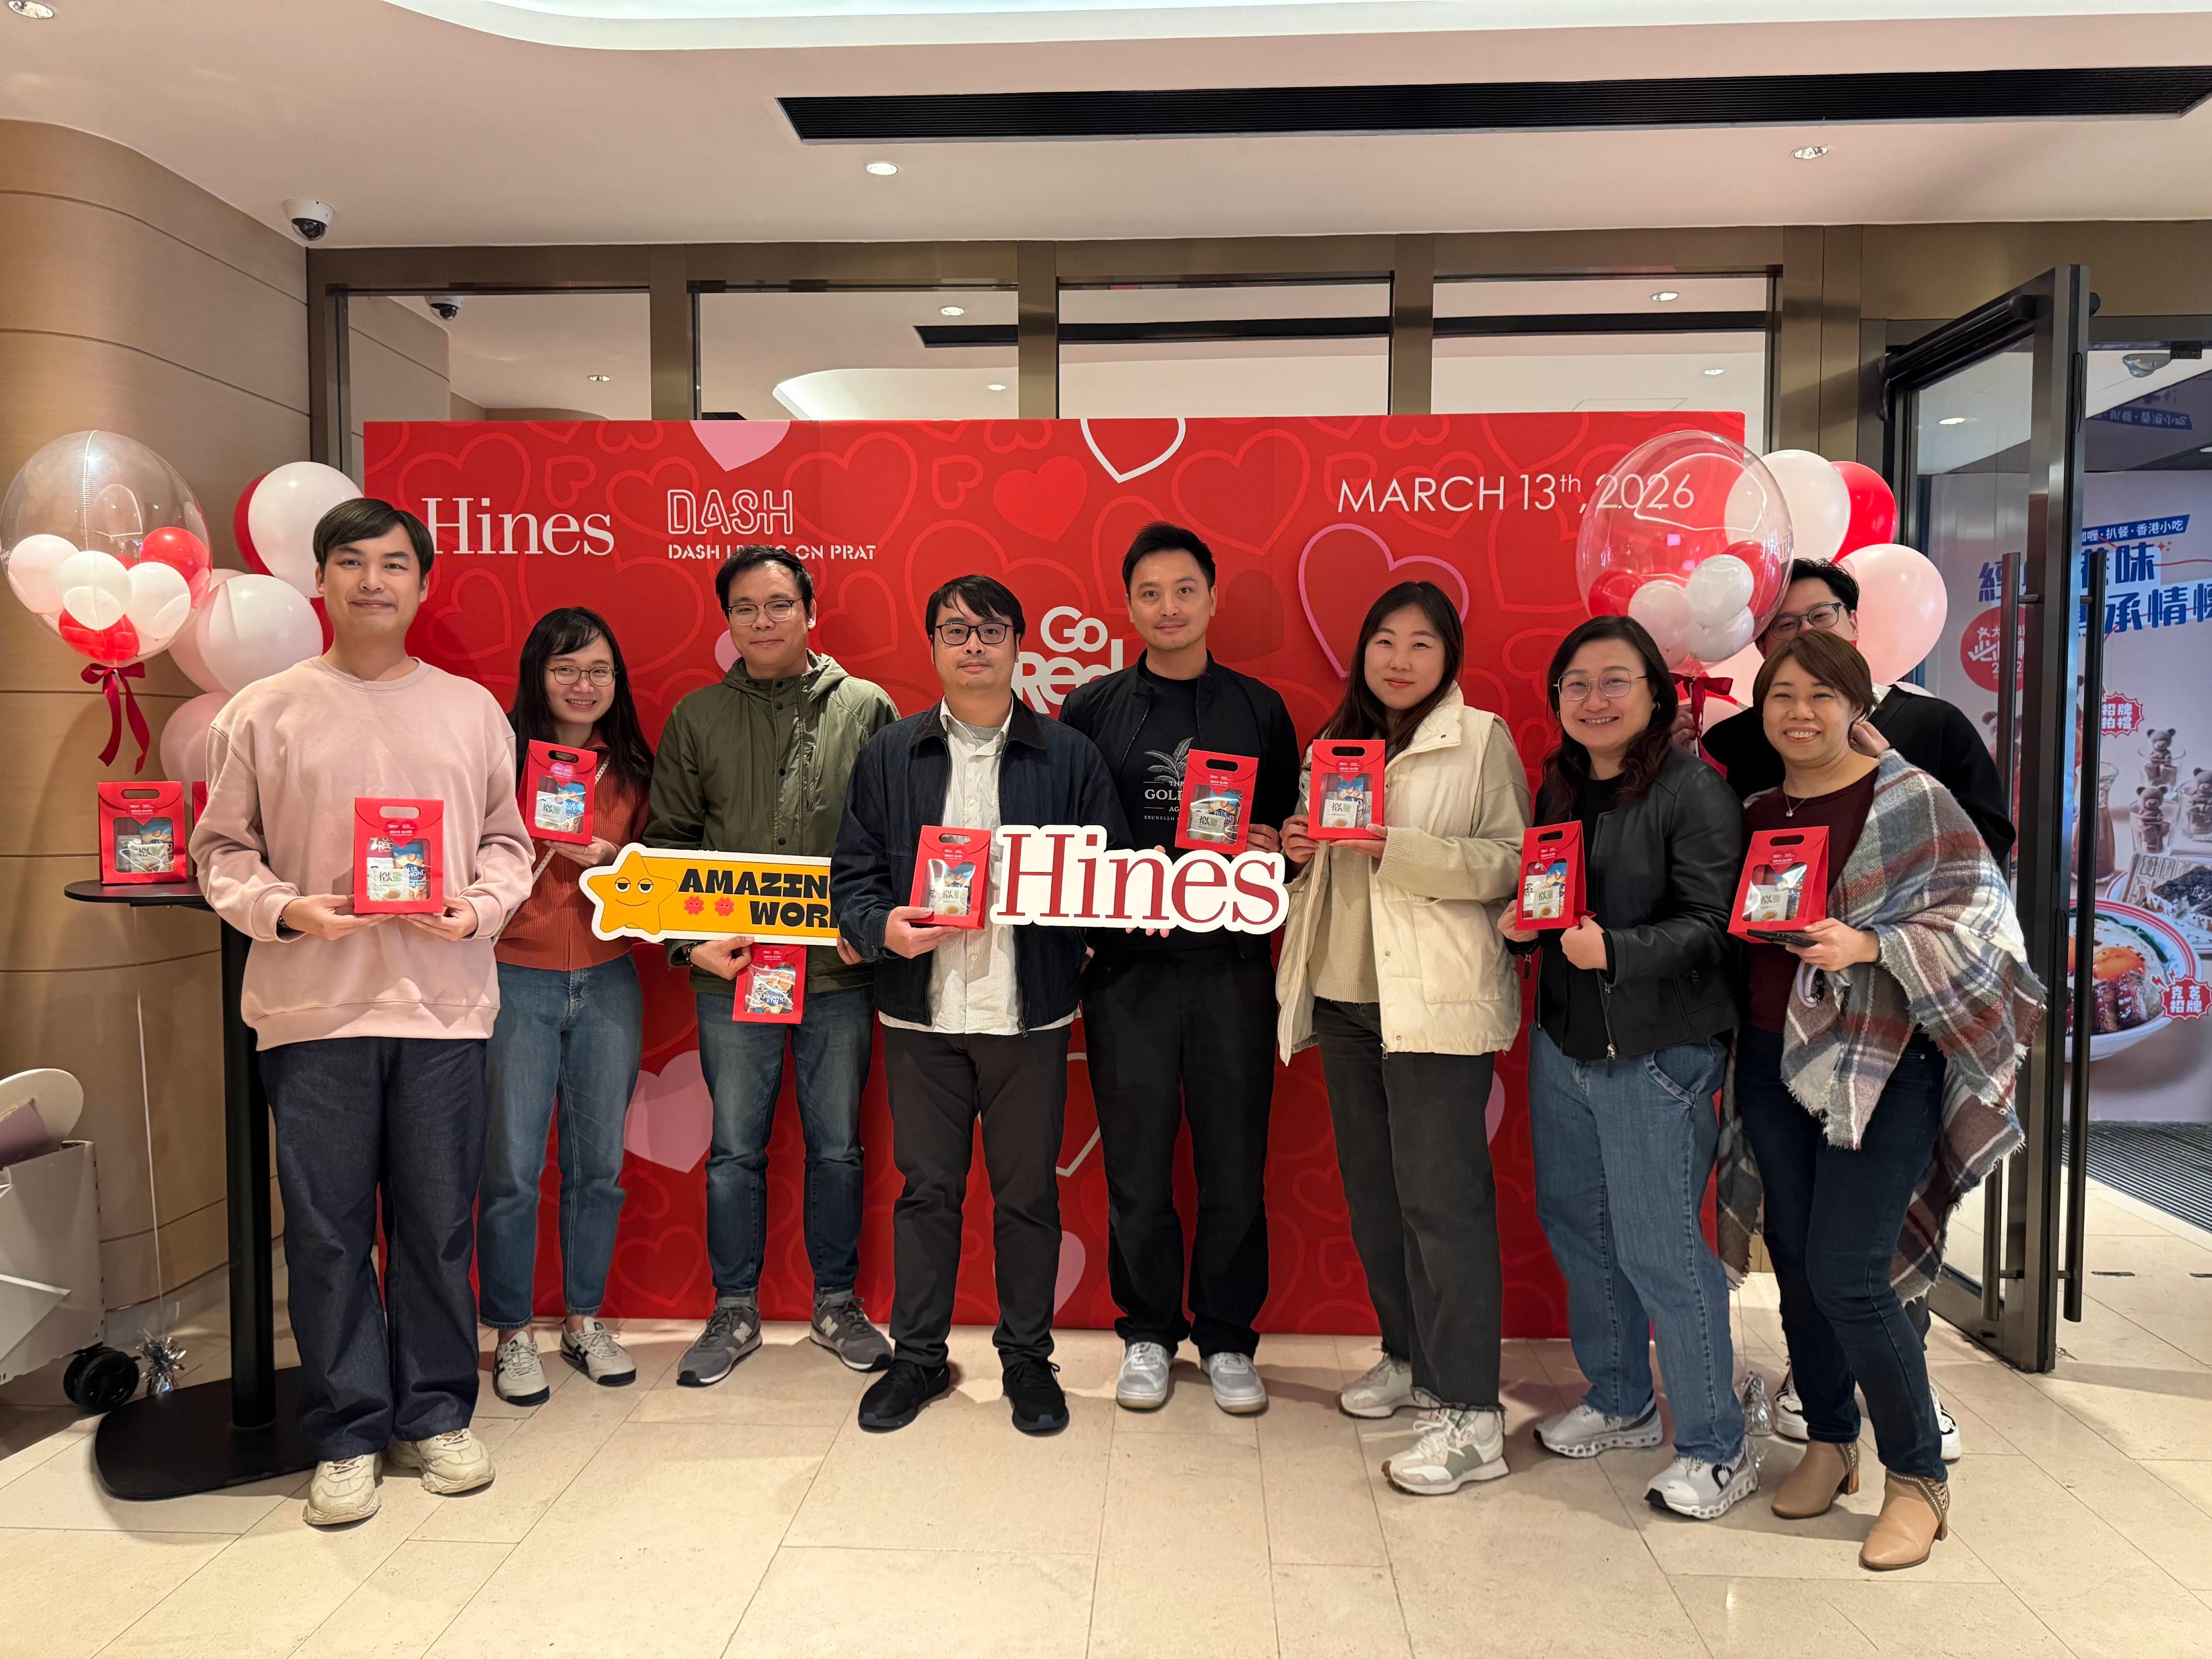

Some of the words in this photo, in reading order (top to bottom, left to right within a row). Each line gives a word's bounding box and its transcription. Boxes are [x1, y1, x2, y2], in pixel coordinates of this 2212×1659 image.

[667, 489, 793, 534] DASH
[1337, 476, 1504, 513] MARCH
[1596, 473, 1694, 509] 2026
[422, 498, 615, 556] Hines
[668, 544, 720, 559] DASH
[795, 545, 824, 560] ON
[830, 545, 877, 560] PRAT
[1040, 606, 1108, 652] Go
[997, 833, 1280, 925] Hines
